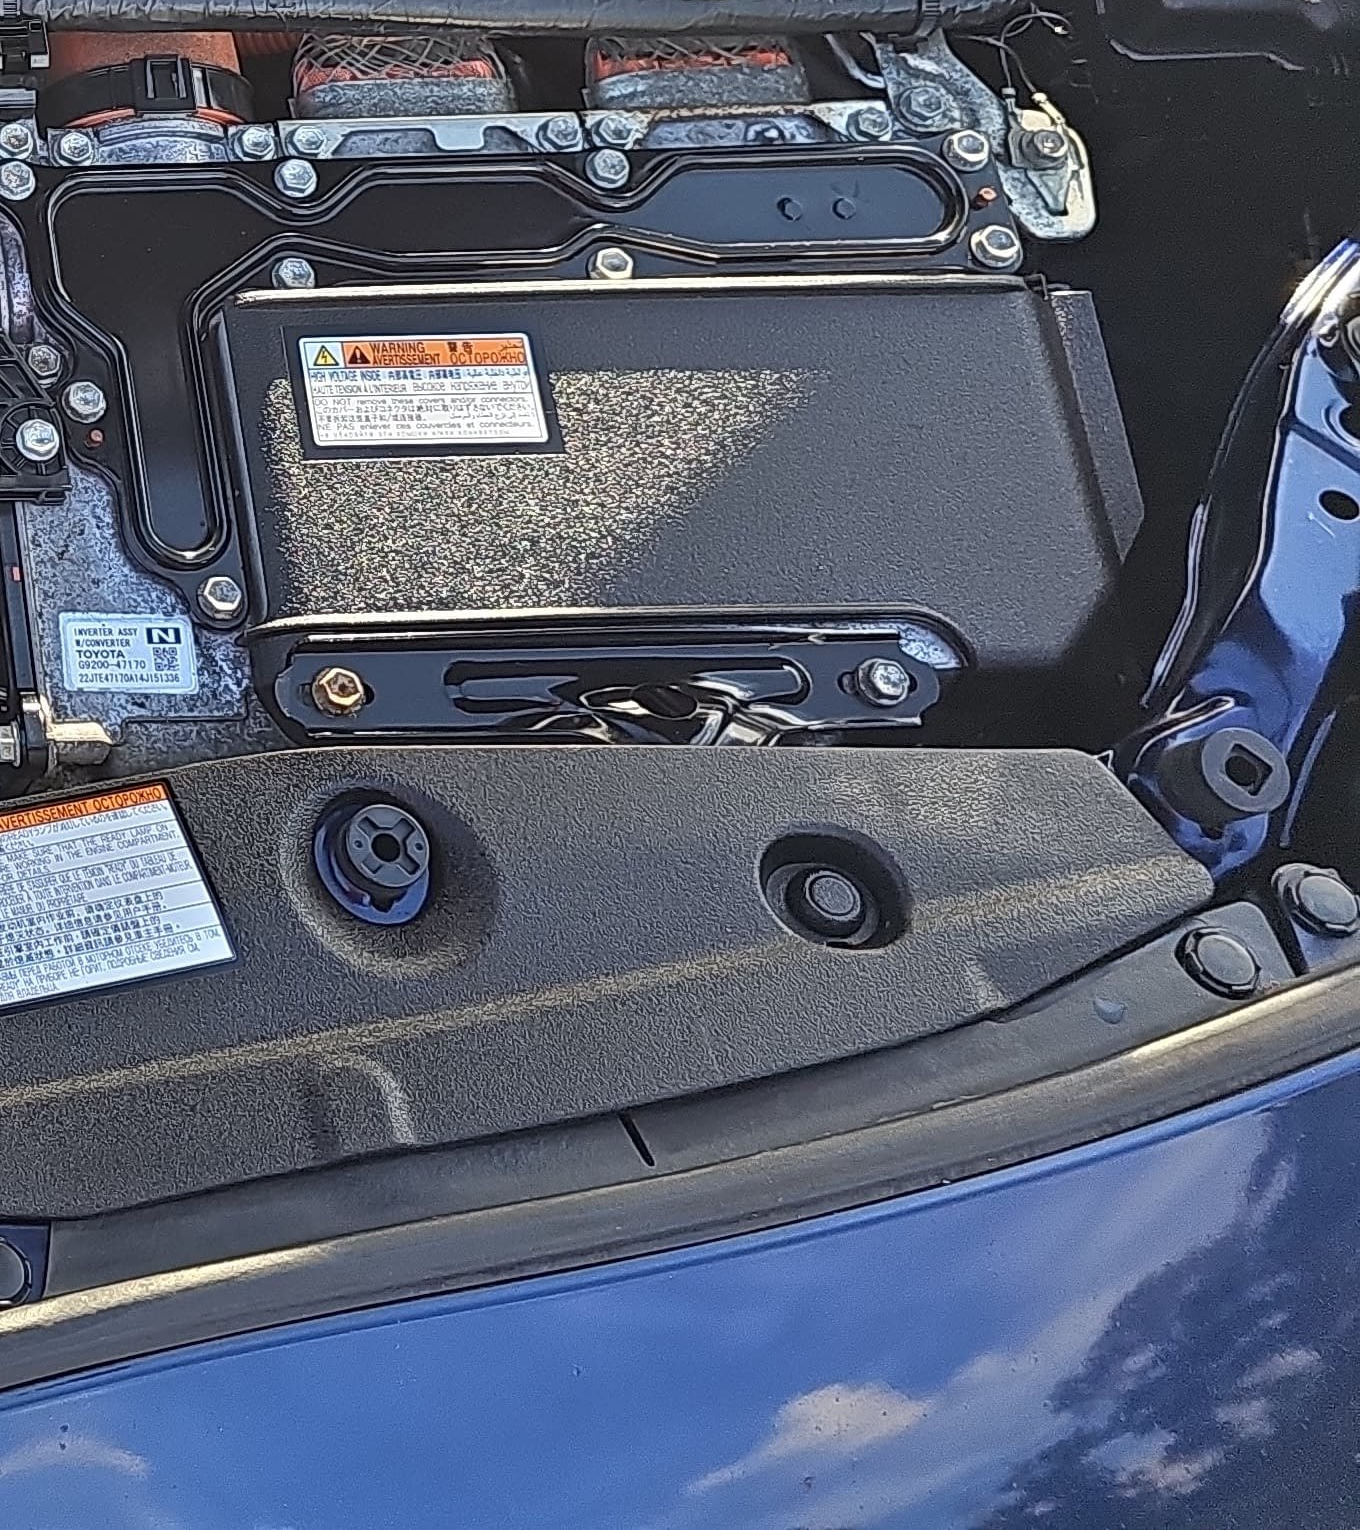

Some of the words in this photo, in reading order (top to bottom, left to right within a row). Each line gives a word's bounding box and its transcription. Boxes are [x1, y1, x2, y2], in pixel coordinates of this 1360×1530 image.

[369, 342, 425, 353] WARNING
[371, 353, 441, 365] AVERTISSEMENT
[449, 351, 524, 364] ОСТОРОЖНО
[328, 370, 358, 382] VOLTAGE
[313, 398, 328, 406] DO
[332, 398, 351, 406] NOT
[390, 396, 413, 405] these
[317, 423, 331, 431] NE
[336, 423, 354, 431] PAS
[74, 627, 113, 636] INVERTER
[117, 627, 138, 635] ASSY
[74, 638, 131, 647] W/CONVERTER
[75, 649, 125, 658] TOYOTA
[91, 787, 162, 811] ОСТОРОЖНО
[6, 851, 29, 863] MAKE
[31, 846, 54, 858] SURE
[56, 841, 78, 853] THAT
[81, 837, 98, 848] THE
[100, 831, 127, 844] READY
[129, 826, 154, 838] LAMP
[155, 823, 169, 833] ON
[13, 855, 52, 871] WORKING
[53, 853, 63, 863] IN
[66, 849, 83, 860] THE
[84, 843, 115, 856] ENGINE
